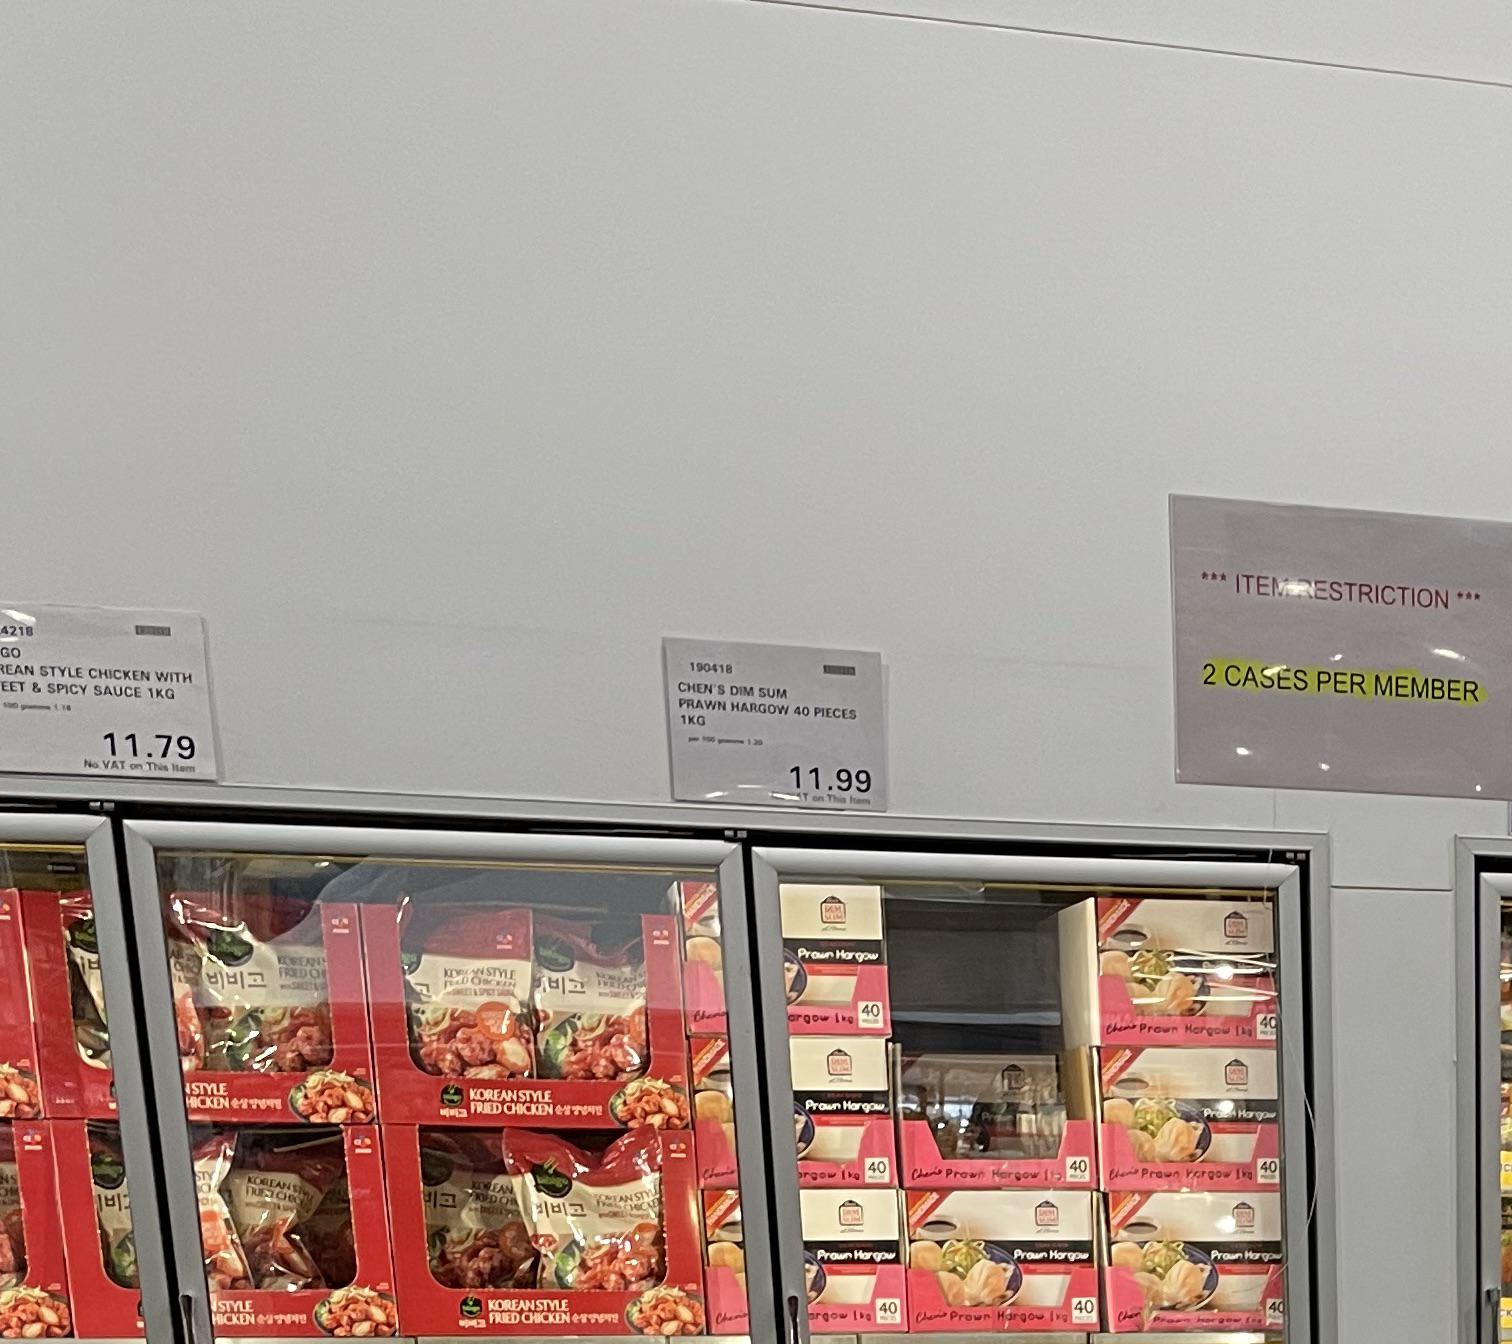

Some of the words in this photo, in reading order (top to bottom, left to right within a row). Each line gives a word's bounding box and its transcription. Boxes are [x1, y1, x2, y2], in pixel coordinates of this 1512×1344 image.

[39, 665, 84, 679] STYLE
[88, 667, 150, 682] CHICKEN
[155, 671, 193, 684] WITH
[689, 661, 733, 674] 190418
[1203, 663, 1216, 685] 2
[1224, 664, 1308, 691] CASES
[1317, 670, 1366, 696] PER
[1374, 673, 1479, 702] MEMBER
[31, 682, 42, 693] &
[47, 683, 88, 696] SPICY
[93, 685, 142, 698] SAUCE
[148, 687, 175, 700] 1KG
[677, 682, 726, 696] CHEN'S
[730, 685, 754, 697] DIM
[758, 687, 788, 699] SUM
[678, 698, 727, 712] PRAWN
[731, 701, 789, 716] HARGOW
[793, 705, 810, 717] 40
[814, 706, 857, 720] PIECES
[680, 714, 706, 726] 1KG
[103, 732, 196, 760] 11.79
[83, 759, 98, 769] No
[102, 760, 126, 770] VAT
[129, 762, 143, 770] on
[146, 761, 168, 772] This
[172, 762, 196, 773] Item
[789, 765, 872, 793] 11.99
[797, 947, 835, 961] Prawn
[835, 948, 879, 963] Hargow
[861, 1004, 880, 1018] 40
[191, 1082, 228, 1095] STYLE
[469, 1087, 517, 1101] KOREAN
[518, 1089, 553, 1102] STYLE
[470, 1102, 502, 1114] FRIED
[503, 1103, 553, 1116] CHICKEN
[805, 1099, 842, 1111] Prawn
[843, 1100, 885, 1113] Hargow
[868, 1160, 887, 1174] 40
[1069, 1159, 1088, 1173] 40
[1013, 1249, 1048, 1260] Prawn
[1049, 1249, 1089, 1262] Hargow
[220, 1300, 253, 1312] STYLE
[488, 1299, 536, 1311] KOREAN
[489, 1312, 520, 1324] FRIED
[521, 1312, 571, 1324] CHICKEN
